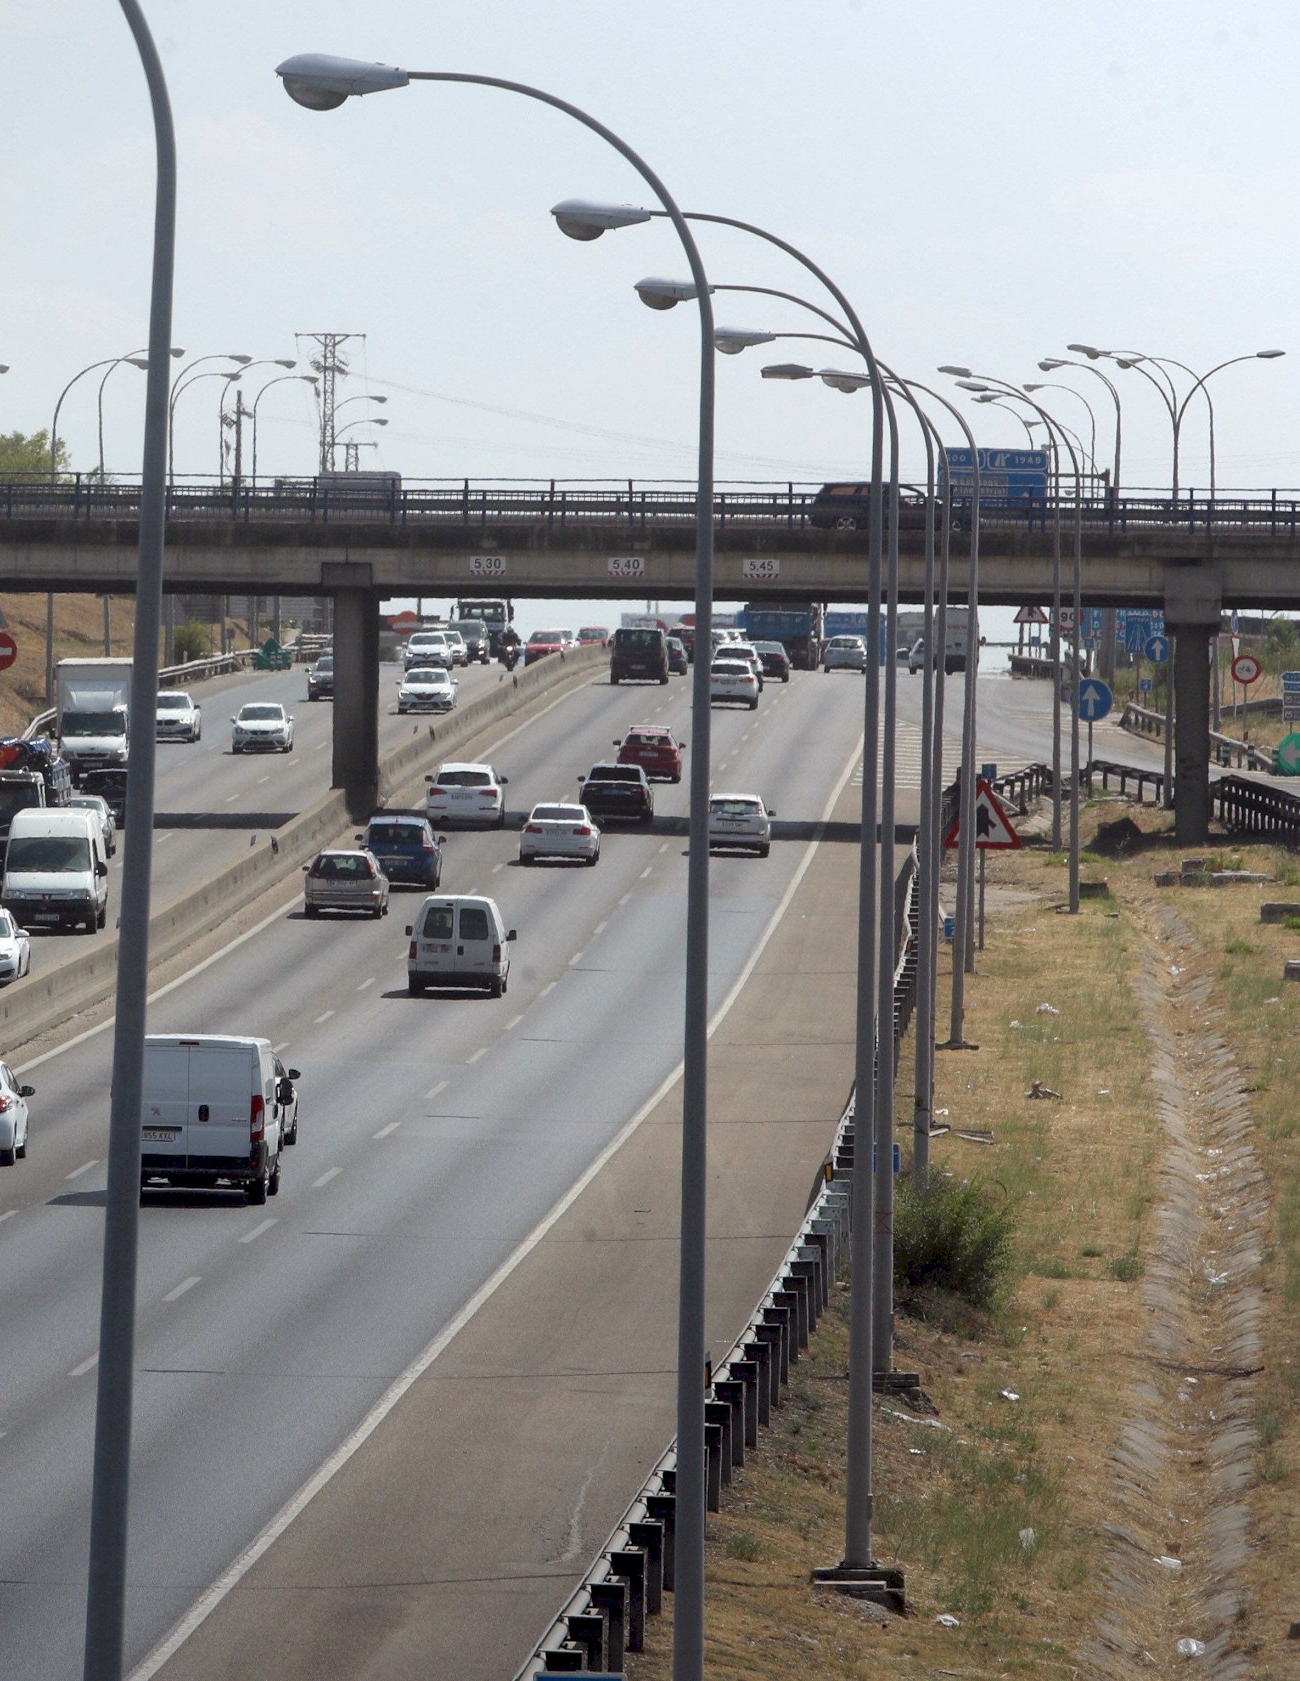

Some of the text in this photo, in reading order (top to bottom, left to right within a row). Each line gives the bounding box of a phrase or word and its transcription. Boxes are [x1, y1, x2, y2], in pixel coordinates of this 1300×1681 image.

[474, 558, 502, 570] 5,30
[612, 559, 640, 571] 5,40
[750, 560, 774, 571] 5,45
